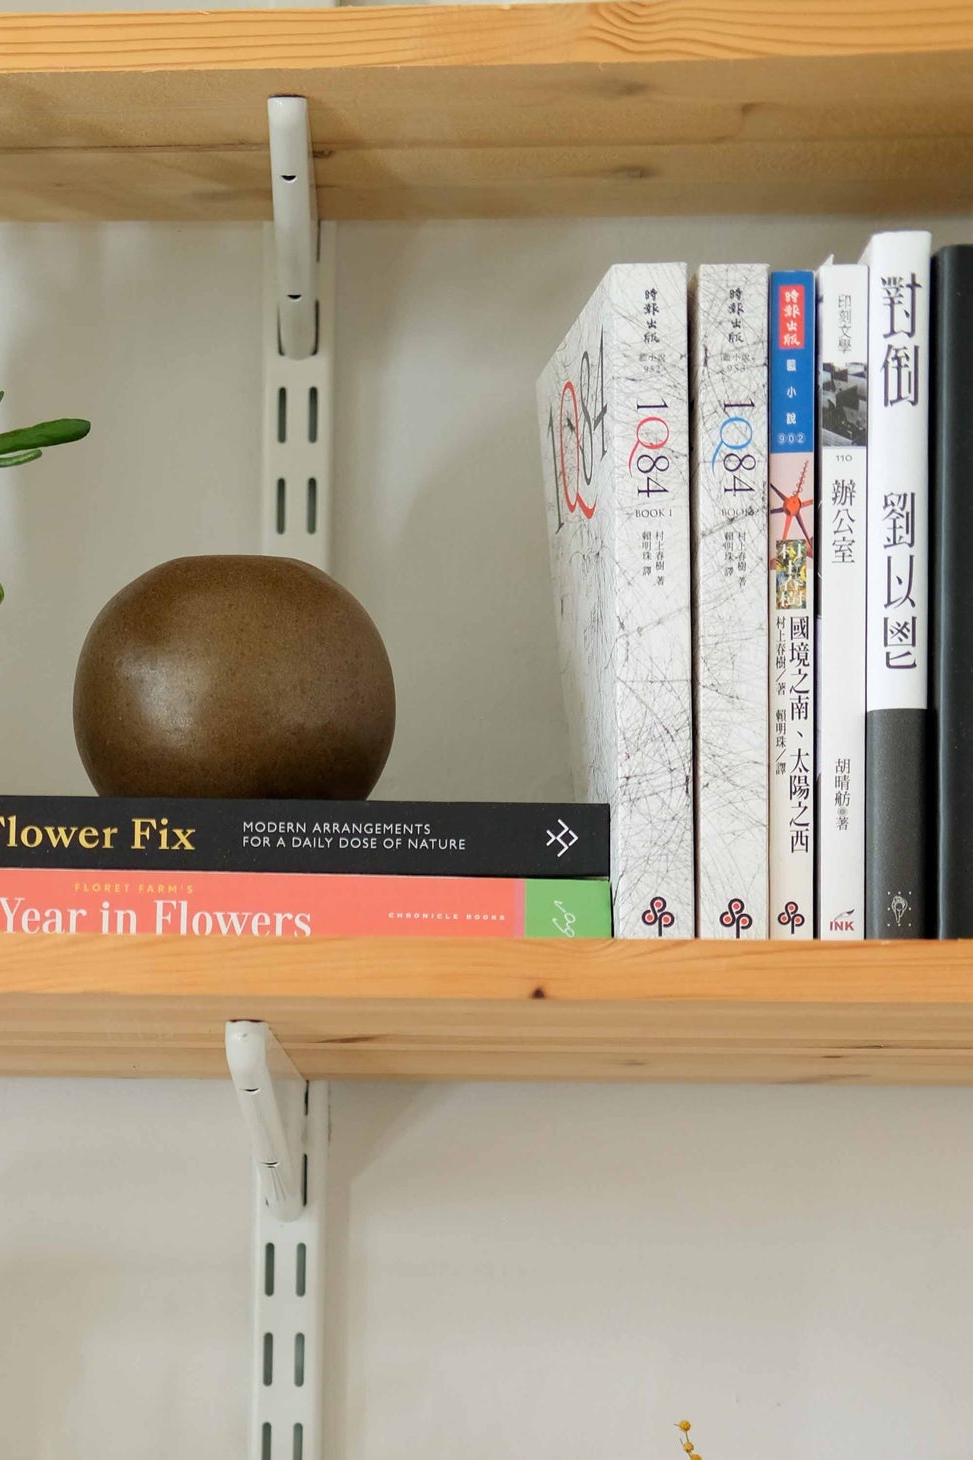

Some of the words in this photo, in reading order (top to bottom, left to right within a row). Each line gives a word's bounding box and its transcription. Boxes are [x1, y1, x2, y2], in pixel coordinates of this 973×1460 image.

[643, 287, 660, 344] 時報出版
[728, 287, 745, 344] 時報出版
[782, 288, 802, 347] 時報出版
[838, 294, 852, 354] 印刻文學
[880, 272, 923, 408] 對倒
[547, 323, 608, 536] 1Q84
[628, 397, 670, 498] 1Q84
[711, 397, 757, 497] 1Q84
[835, 454, 853, 463] 110
[635, 508, 666, 518] BOOK
[831, 479, 857, 564] 辦公室
[882, 492, 918, 670] 劉以鬯
[789, 615, 811, 854] 國境之南、太陽之西
[130, 817, 196, 851] Fix
[242, 821, 307, 834] MODERN
[313, 822, 431, 836] ARRANGEMENTS
[242, 835, 271, 848] FOR
[276, 836, 286, 848] A
[291, 836, 333, 849] DAILY
[339, 837, 378, 850] DOSE
[383, 837, 403, 850] OF
[407, 837, 466, 851] NATURE
[74, 883, 130, 894] FLORET
[139, 884, 195, 895] FARM'S
[388, 911, 459, 920] CHRONICLE
[99, 901, 137, 936] in
[153, 899, 312, 937] Flowers
[829, 921, 856, 932] INK
